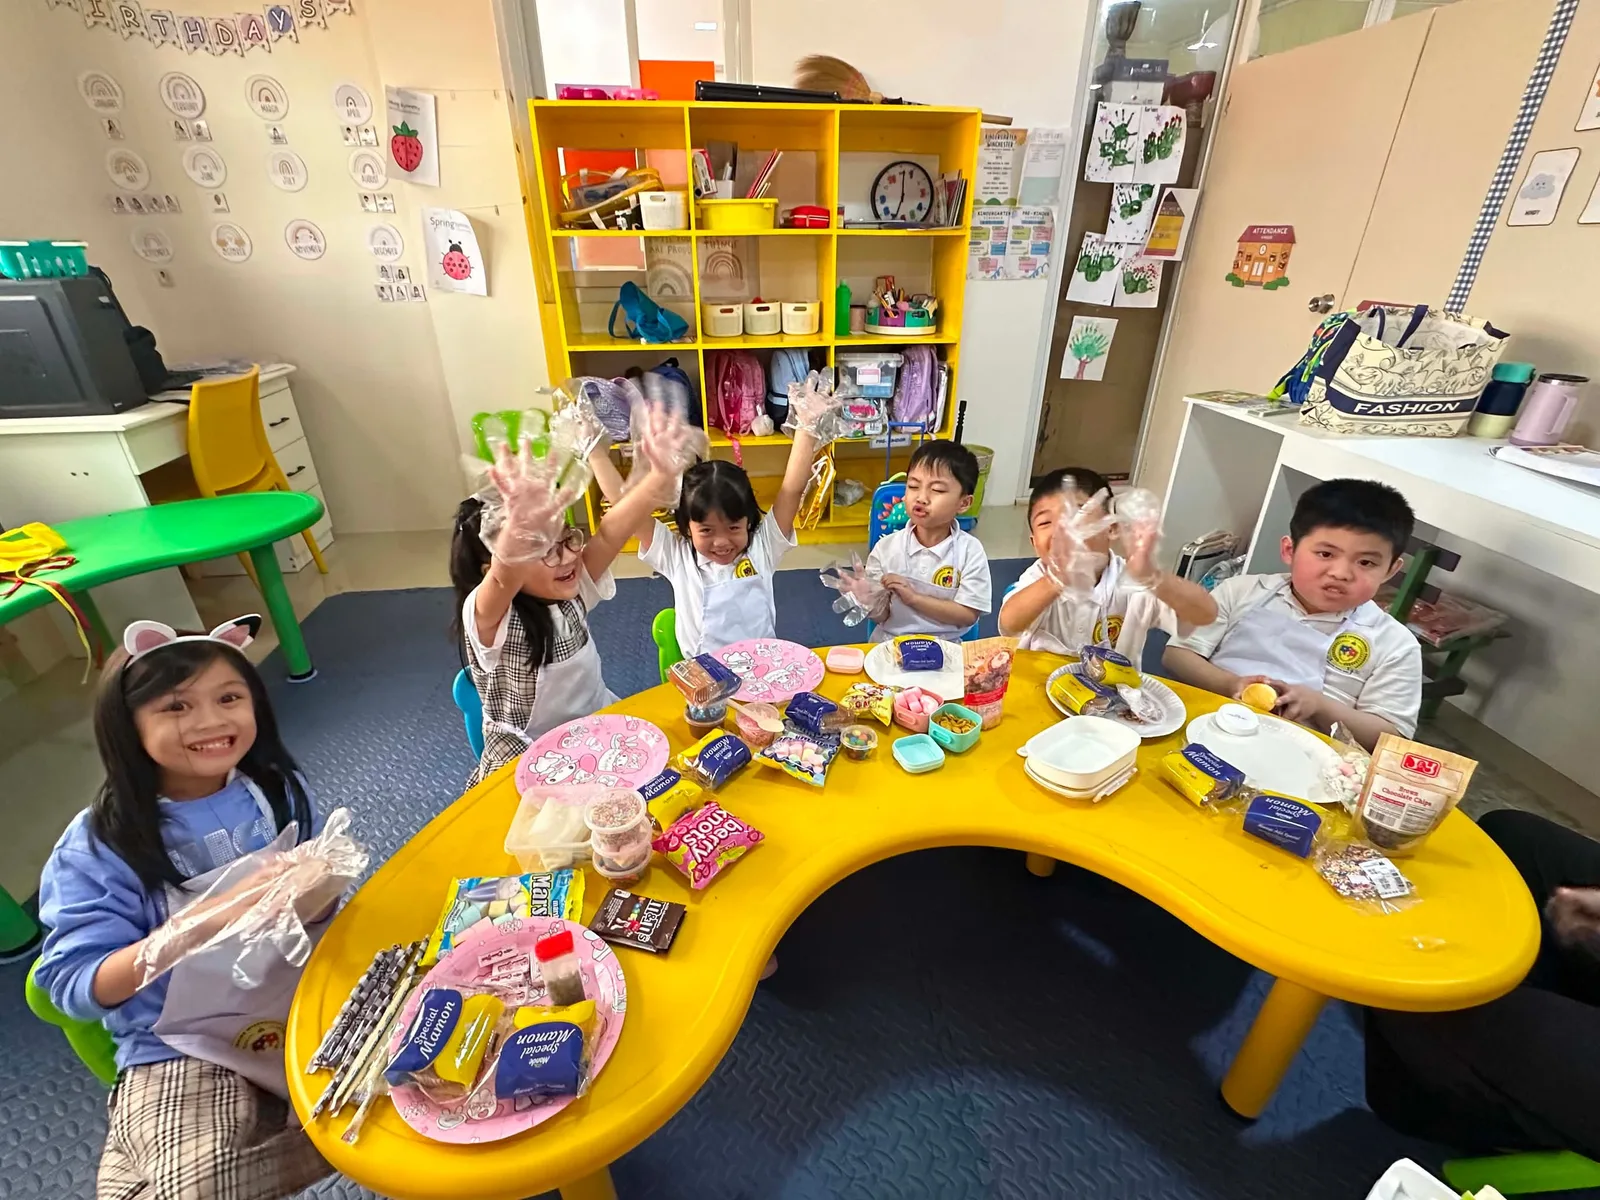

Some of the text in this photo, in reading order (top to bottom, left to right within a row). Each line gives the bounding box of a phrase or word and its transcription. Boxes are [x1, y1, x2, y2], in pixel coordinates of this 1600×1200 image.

[429, 216, 456, 232] Spring
[1252, 227, 1288, 235] ATTENDANCE
[1353, 402, 1461, 415] FASHION
[703, 736, 729, 760] Mamon
[1183, 750, 1222, 776] Mamon
[645, 775, 677, 800] Mamon
[1382, 787, 1432, 807] Chocolate Chips
[1398, 786, 1419, 796] Brown
[1265, 797, 1314, 817] Mamon
[1268, 804, 1302, 818] Special
[681, 808, 729, 847] knots
[691, 819, 743, 864] berry
[530, 872, 553, 918] Mars
[413, 1007, 440, 1046] Special
[419, 1000, 456, 1061] Mamon
[516, 1028, 576, 1045] Mamon
[520, 1040, 560, 1059] Special
